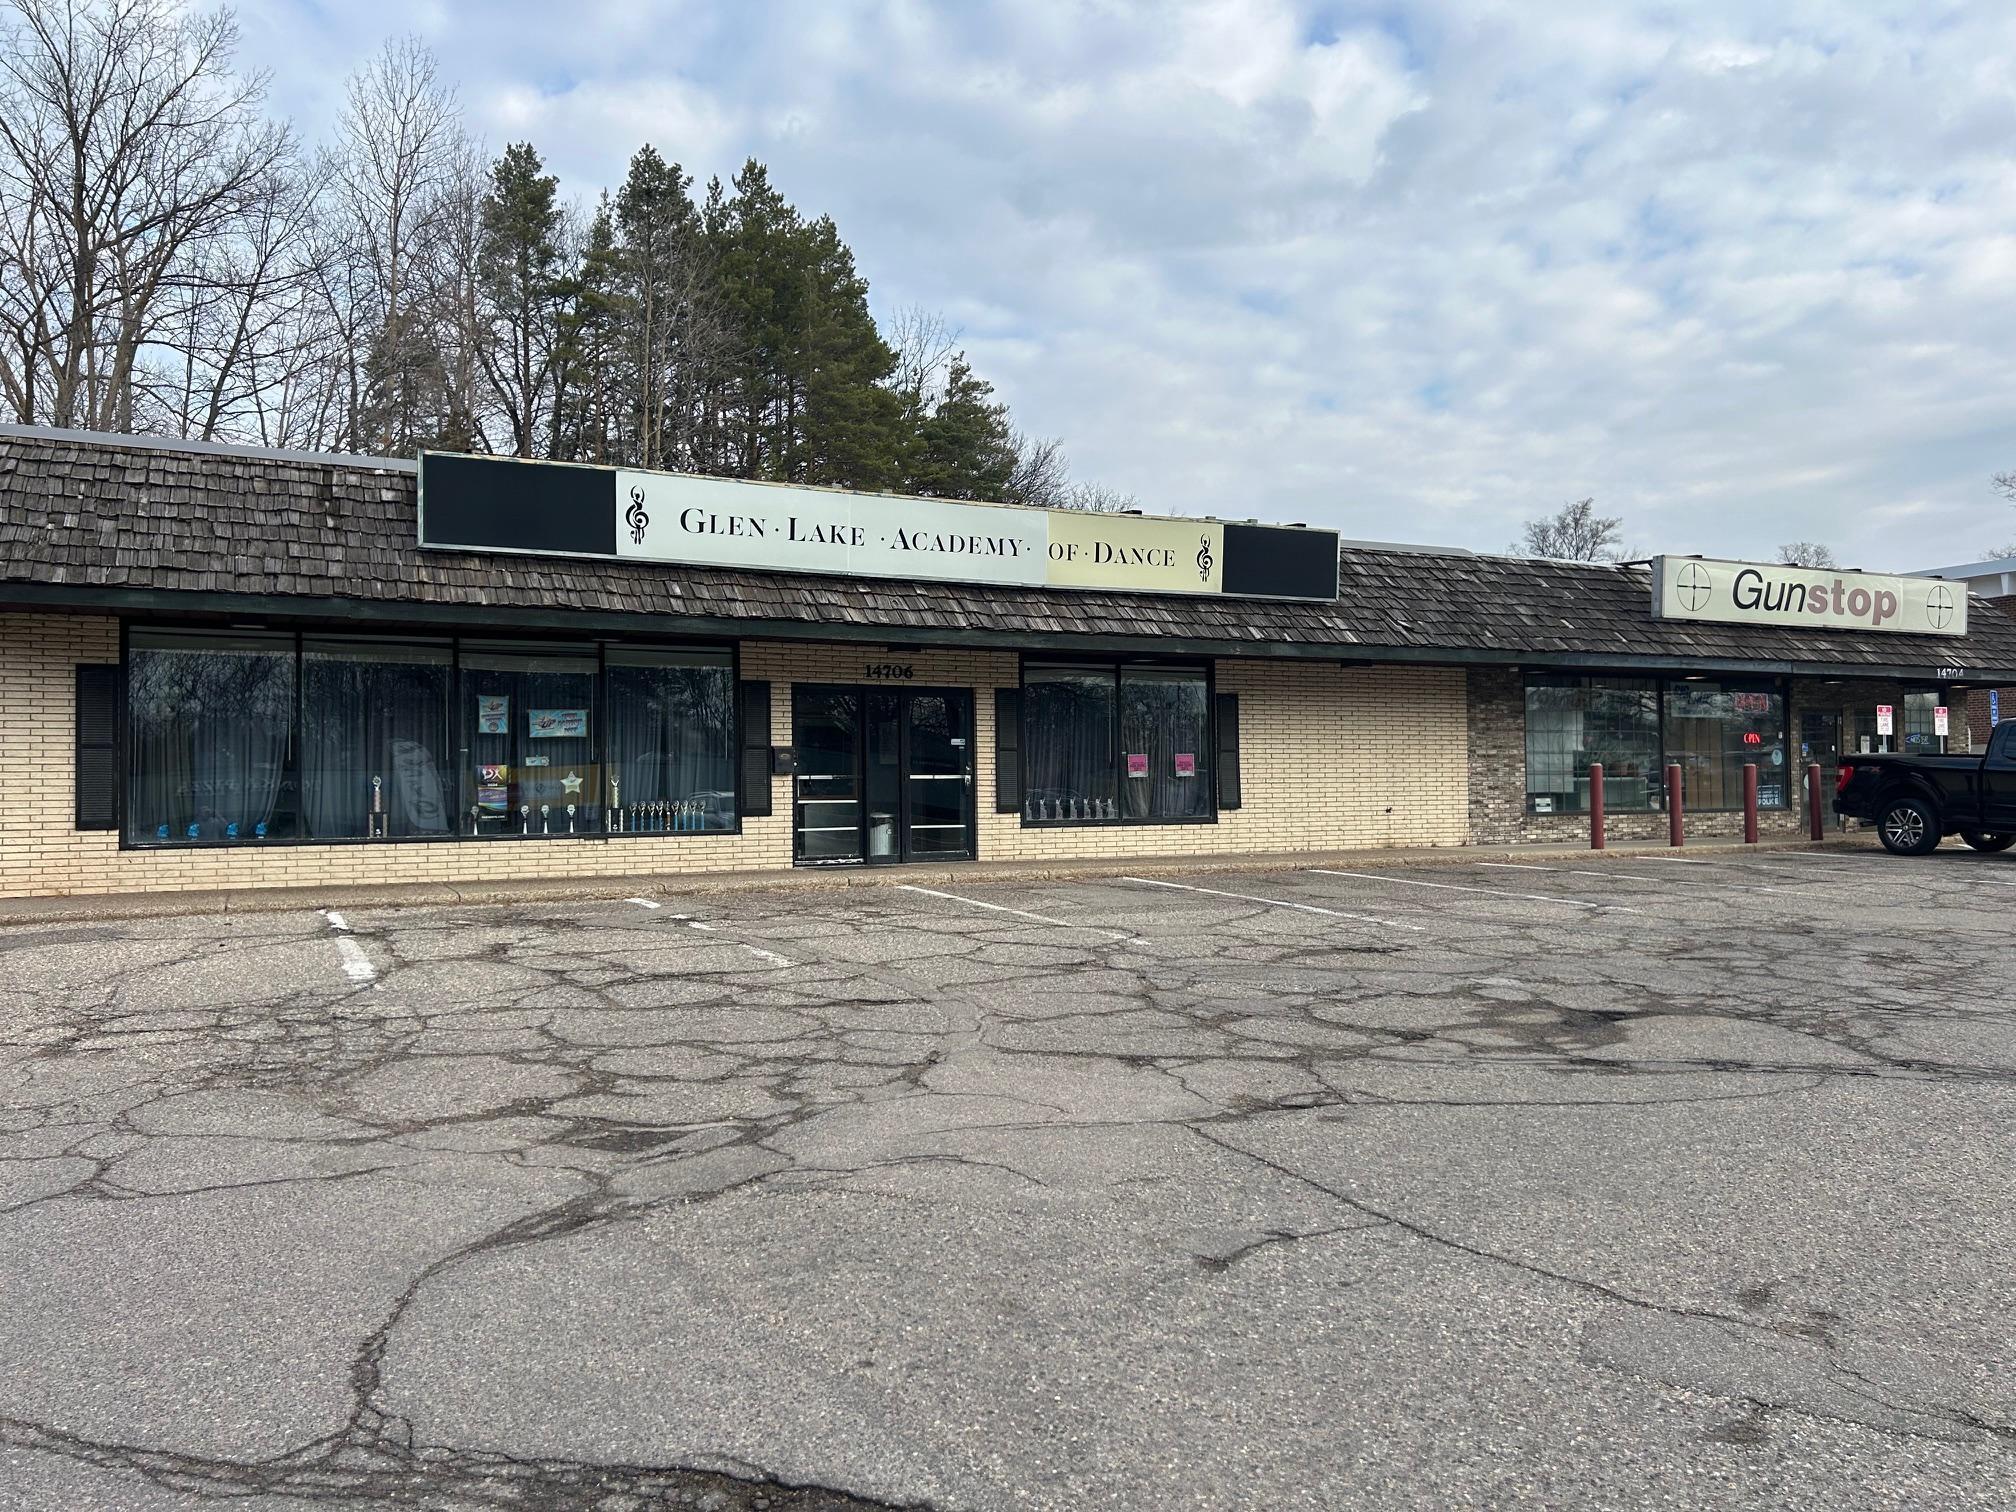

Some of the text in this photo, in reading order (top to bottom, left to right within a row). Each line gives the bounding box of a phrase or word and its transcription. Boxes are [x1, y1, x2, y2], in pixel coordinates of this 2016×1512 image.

[680, 508, 1176, 568] GLEN LAKE ACADEMY OF DANCE
[1732, 568, 1898, 626] Gunstop
[865, 664, 914, 679] 14706
[1936, 667, 1964, 679] 14704
